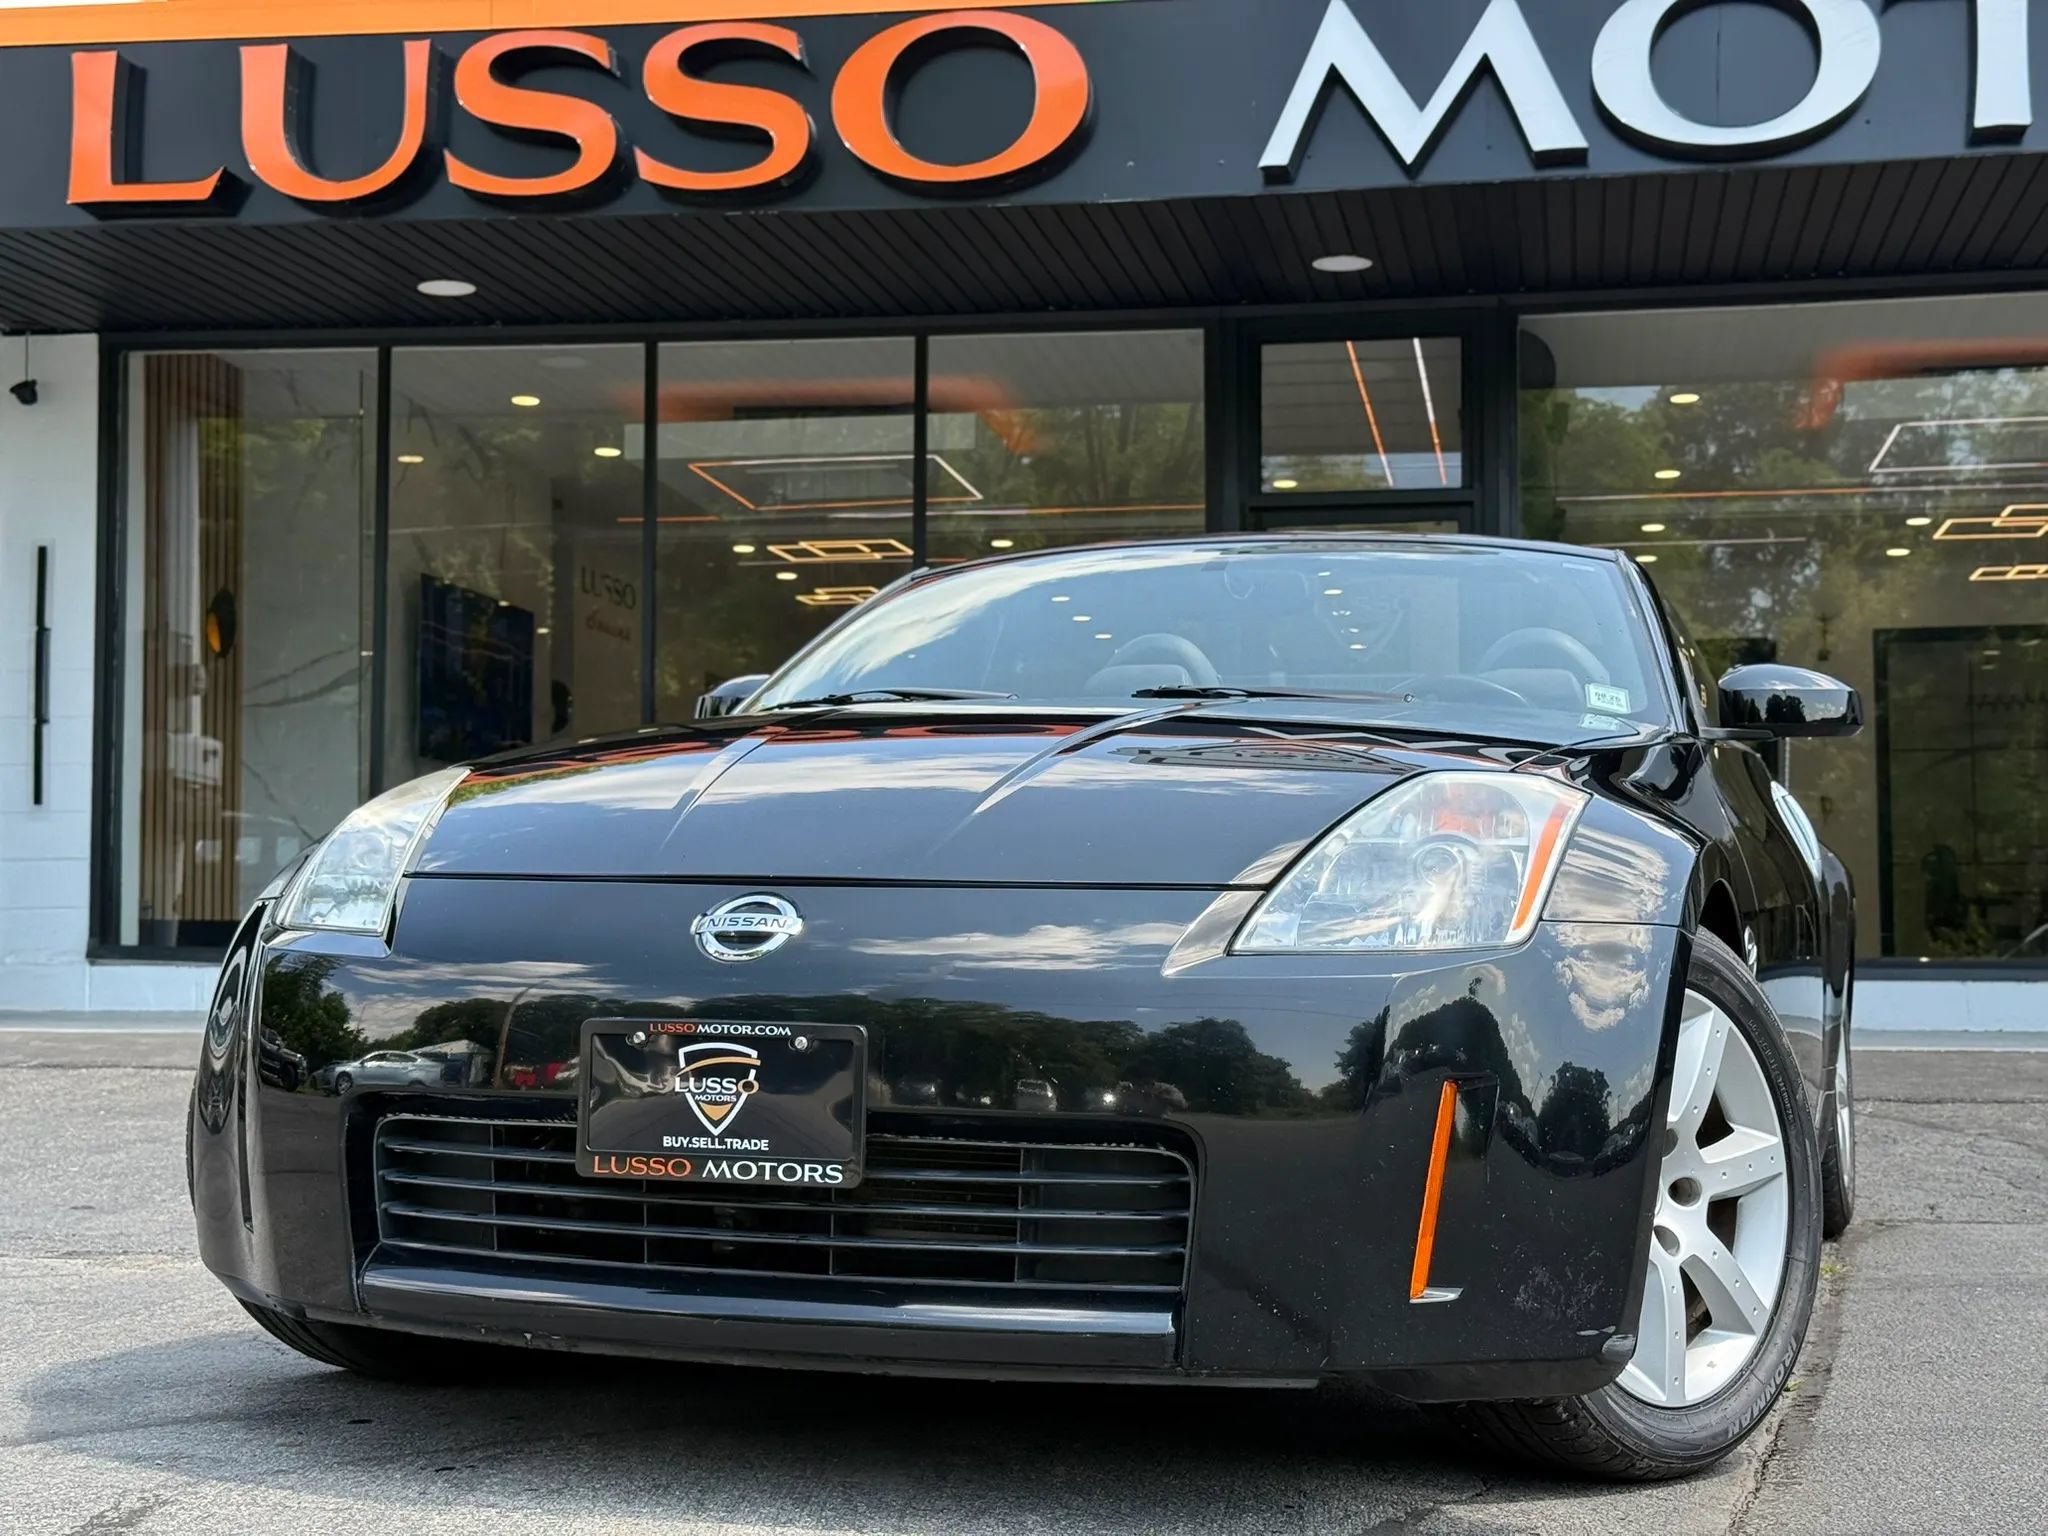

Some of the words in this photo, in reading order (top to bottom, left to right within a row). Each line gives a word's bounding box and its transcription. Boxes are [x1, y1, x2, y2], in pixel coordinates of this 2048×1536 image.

[67, 10, 1090, 204] LUSSO
[707, 916, 788, 930] NISSAN
[649, 1023, 792, 1036] LUSSOMOTOR.COM
[674, 1077, 760, 1095] LUSSO
[694, 1094, 737, 1102] MOTORS
[662, 1135, 770, 1151] BUY.SELL.TRADE
[592, 1155, 692, 1177] LUSSO
[702, 1158, 844, 1184] MOTORS
[1727, 1335, 1798, 1440] IRONMAN
